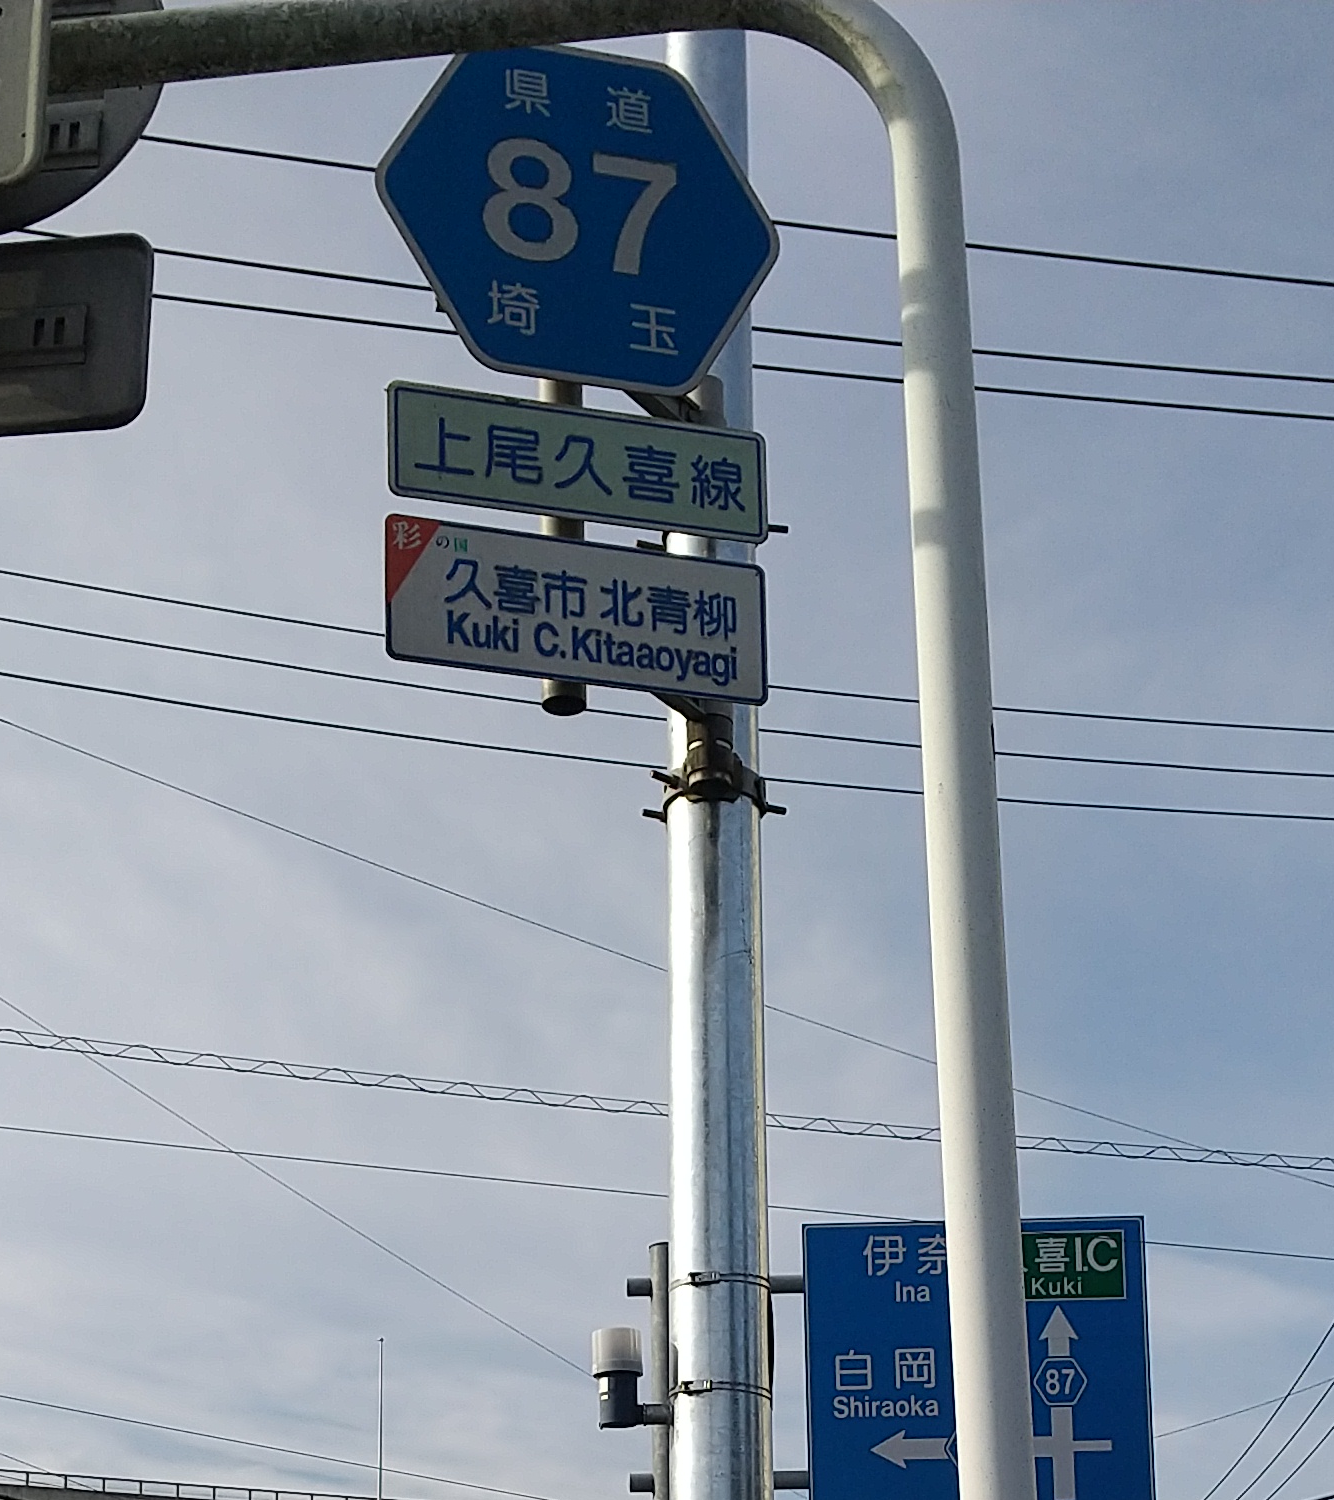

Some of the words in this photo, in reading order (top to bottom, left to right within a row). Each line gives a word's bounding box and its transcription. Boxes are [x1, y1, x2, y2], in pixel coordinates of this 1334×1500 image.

[482, 136, 678, 276] 87
[413, 416, 747, 514] 上尾久喜線
[446, 609, 521, 653] Kuki
[1022, 1236, 1119, 1275] 喜I.C
[895, 1281, 931, 1303] Ina
[1030, 1277, 1083, 1297] Kuki
[1044, 1368, 1076, 1396] 87
[833, 1395, 940, 1420] Shiraoka
